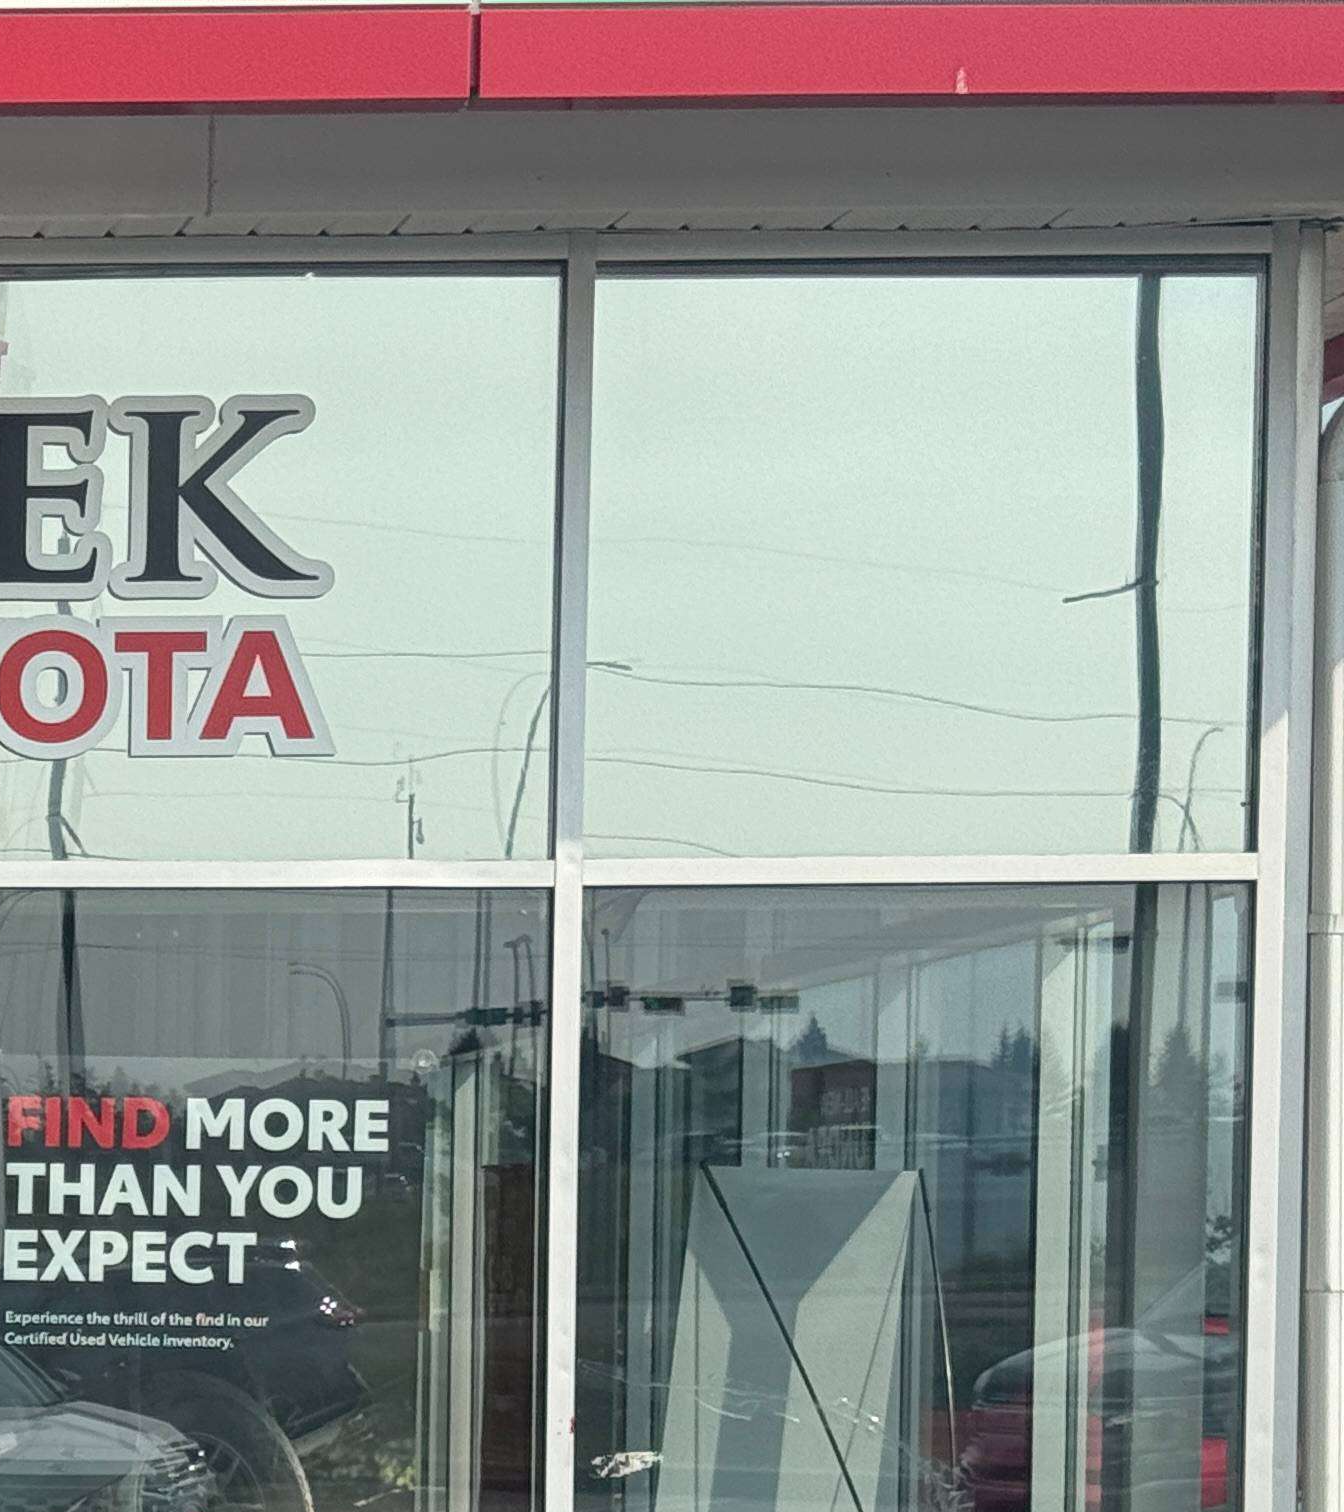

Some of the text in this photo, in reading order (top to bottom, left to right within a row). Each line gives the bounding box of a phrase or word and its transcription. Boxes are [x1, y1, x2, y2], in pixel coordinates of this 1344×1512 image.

[7, 1095, 390, 1153] FIND MORE
[5, 1162, 364, 1220] THAN YOU
[3, 1229, 258, 1285] EXPECT
[4, 1331, 235, 1351] Certified Used Vehicle inventory.
[5, 1310, 269, 1327] Experience the thrill of the find in our
